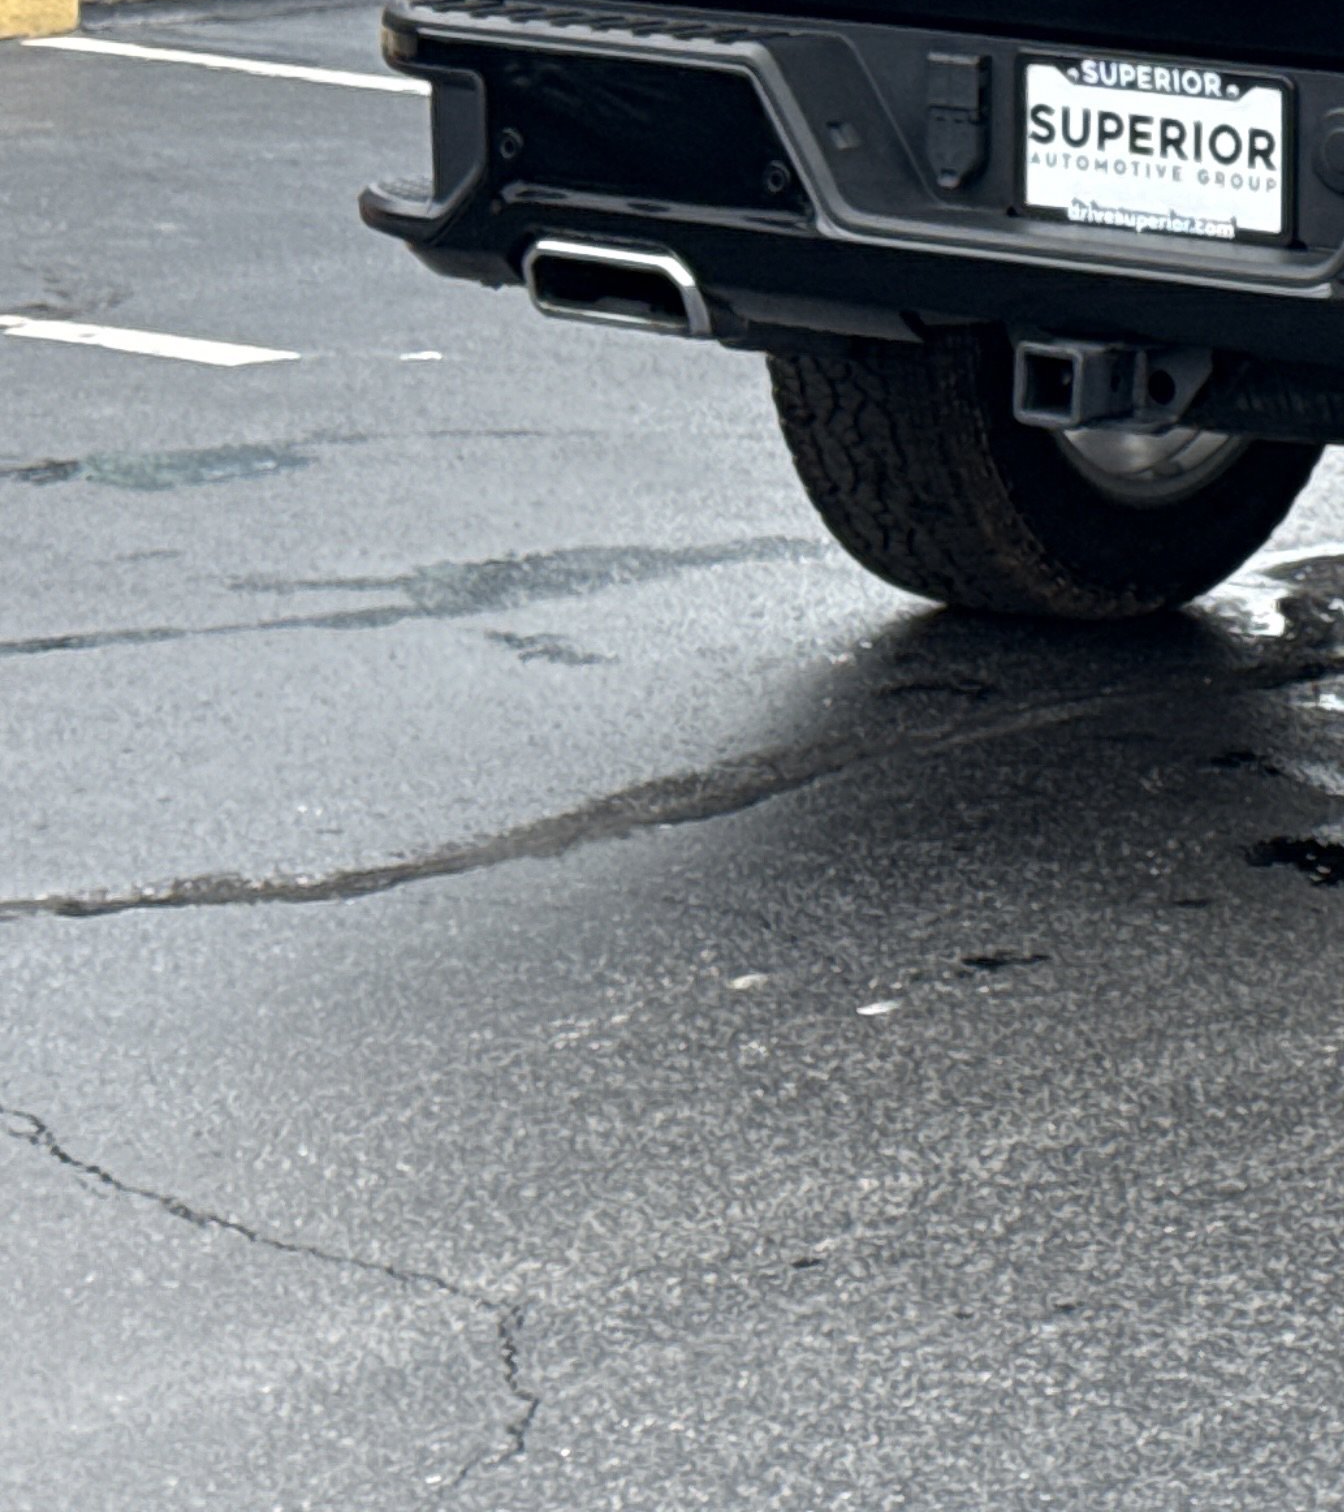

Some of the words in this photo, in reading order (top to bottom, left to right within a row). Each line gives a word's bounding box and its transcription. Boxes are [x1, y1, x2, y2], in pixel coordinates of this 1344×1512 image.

[1080, 59, 1222, 97] SUPERIOR
[1028, 103, 1277, 171] SUPERIOR
[1030, 152, 1183, 181] AUTOMOTIVE
[1197, 168, 1277, 192] GROUP
